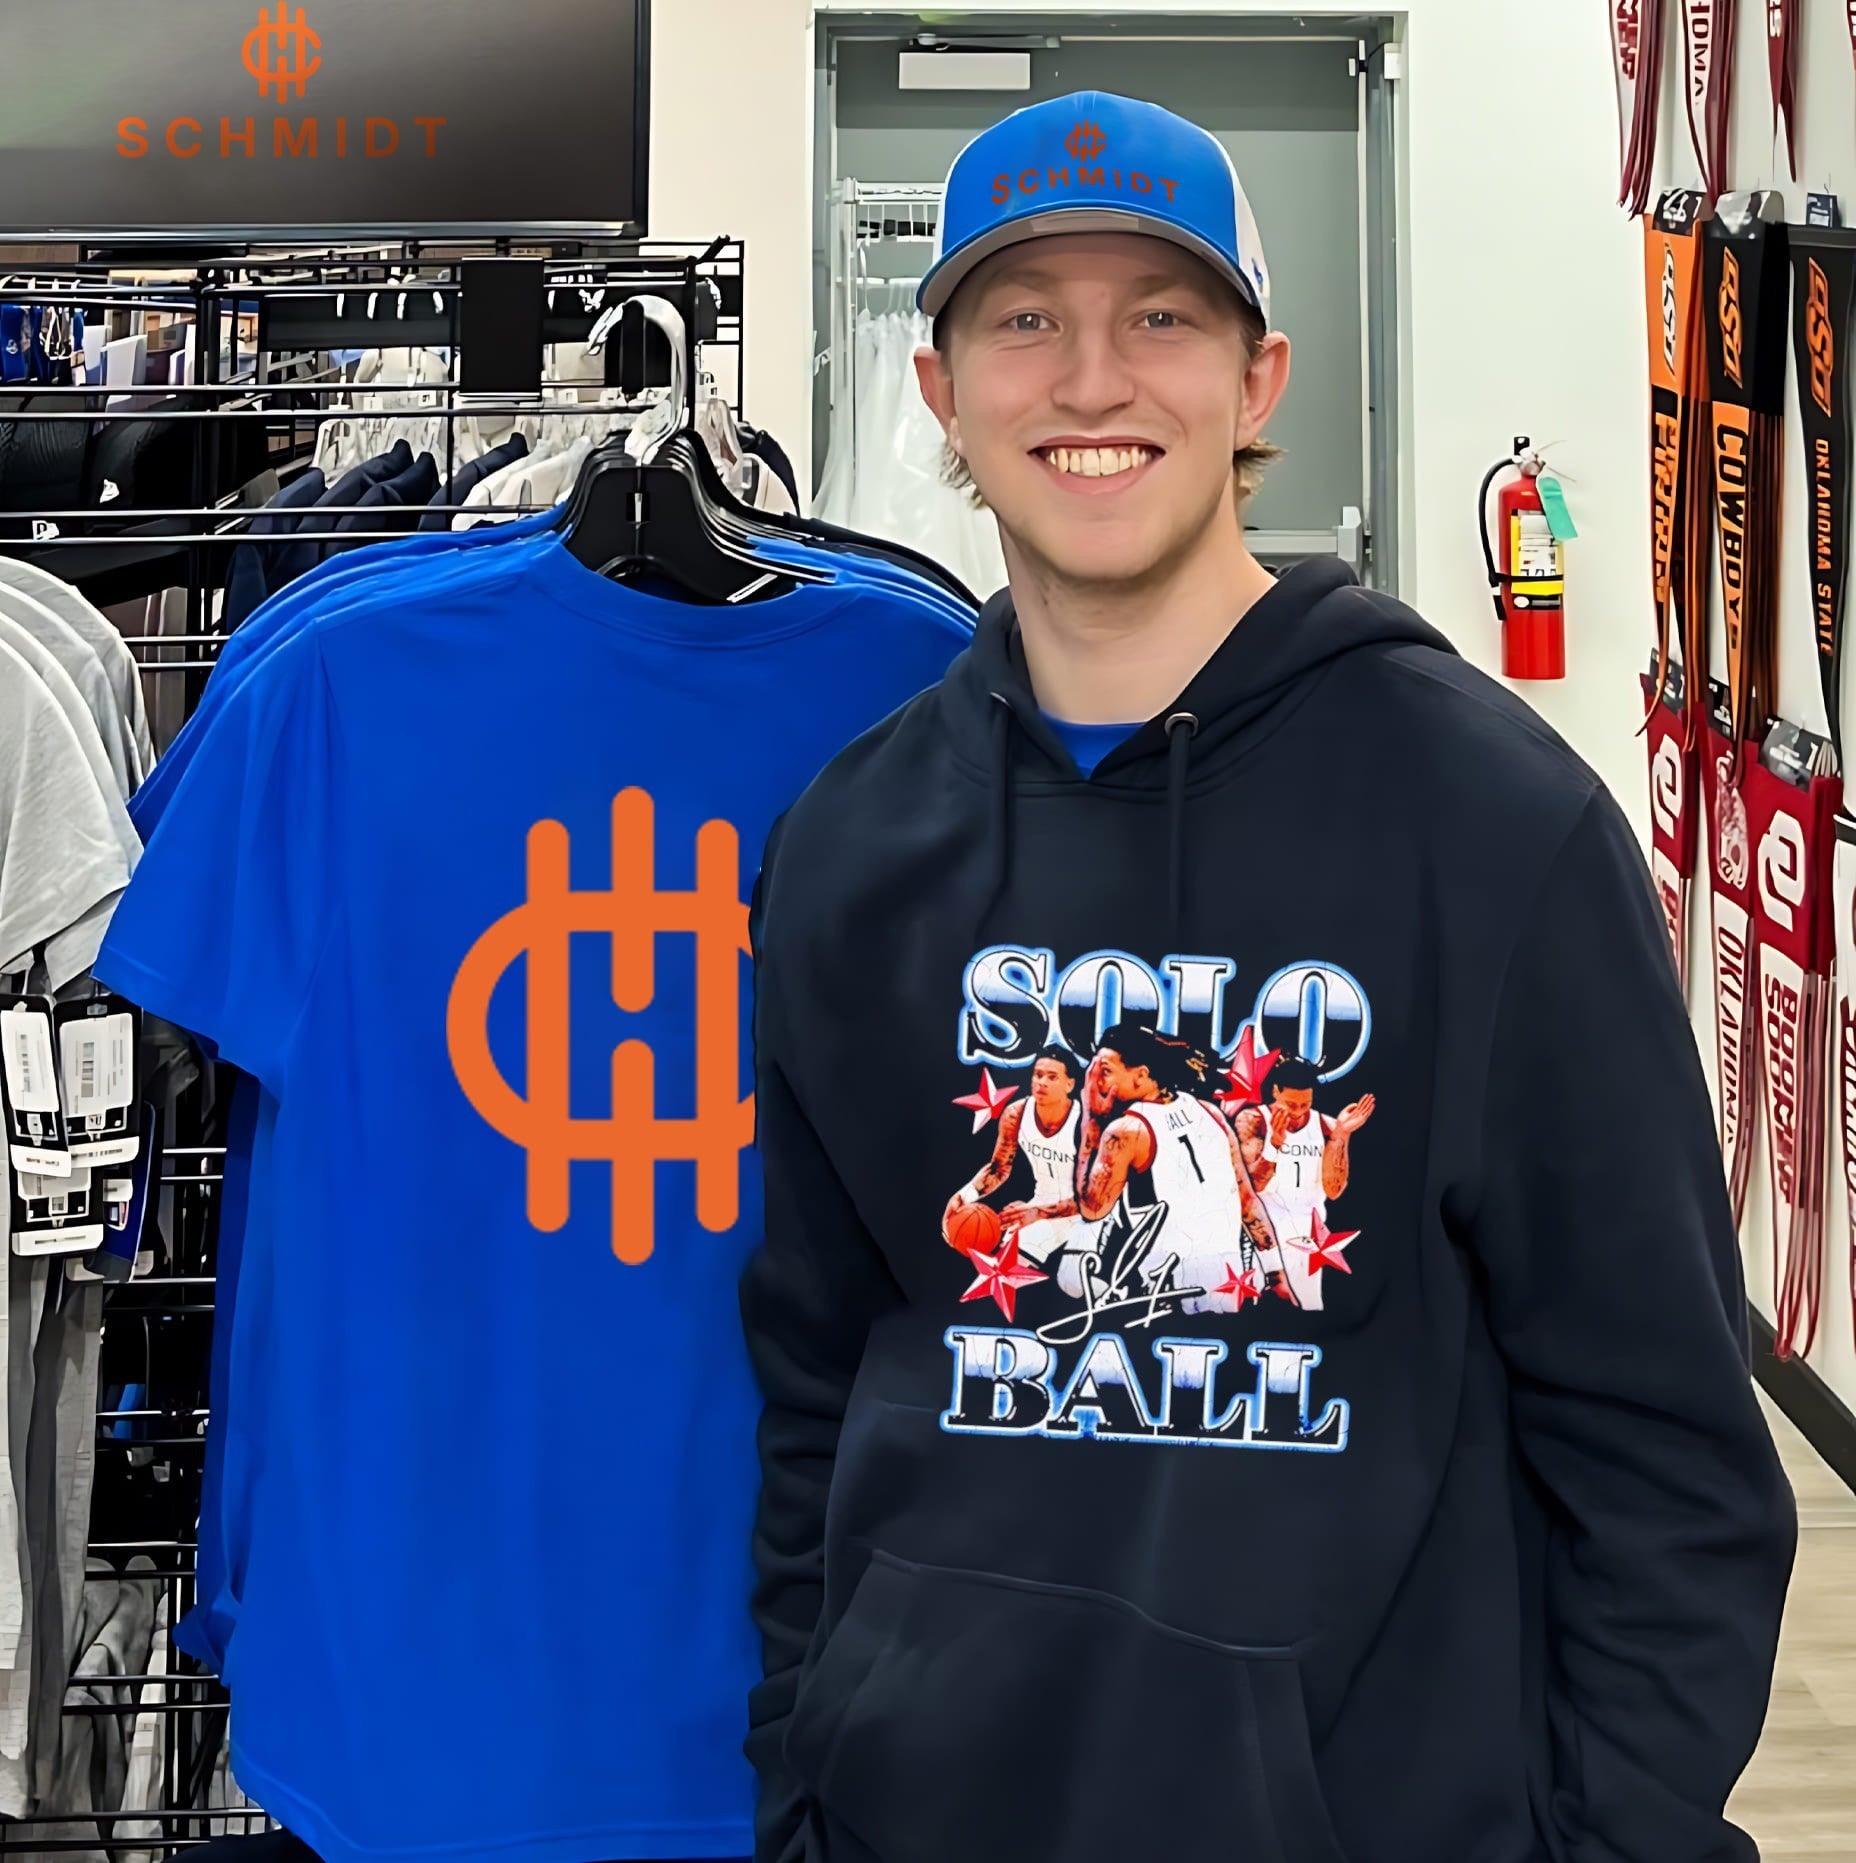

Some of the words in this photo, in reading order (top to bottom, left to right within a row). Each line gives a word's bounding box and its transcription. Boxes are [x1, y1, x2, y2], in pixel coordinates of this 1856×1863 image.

[115, 116, 447, 159] SCHMIDT
[991, 167, 1179, 204] SCHMIDT
[1815, 438, 1832, 570] OKLAHOMA
[957, 944, 1372, 1083] SOLO
[1718, 925, 1745, 1144] OKLAHOMA
[1047, 1162, 1054, 1179] 1
[1177, 1133, 1205, 1184] 1
[1276, 1142, 1323, 1158] CONN
[1293, 1161, 1300, 1188] 1
[939, 1325, 1350, 1453] BALL
